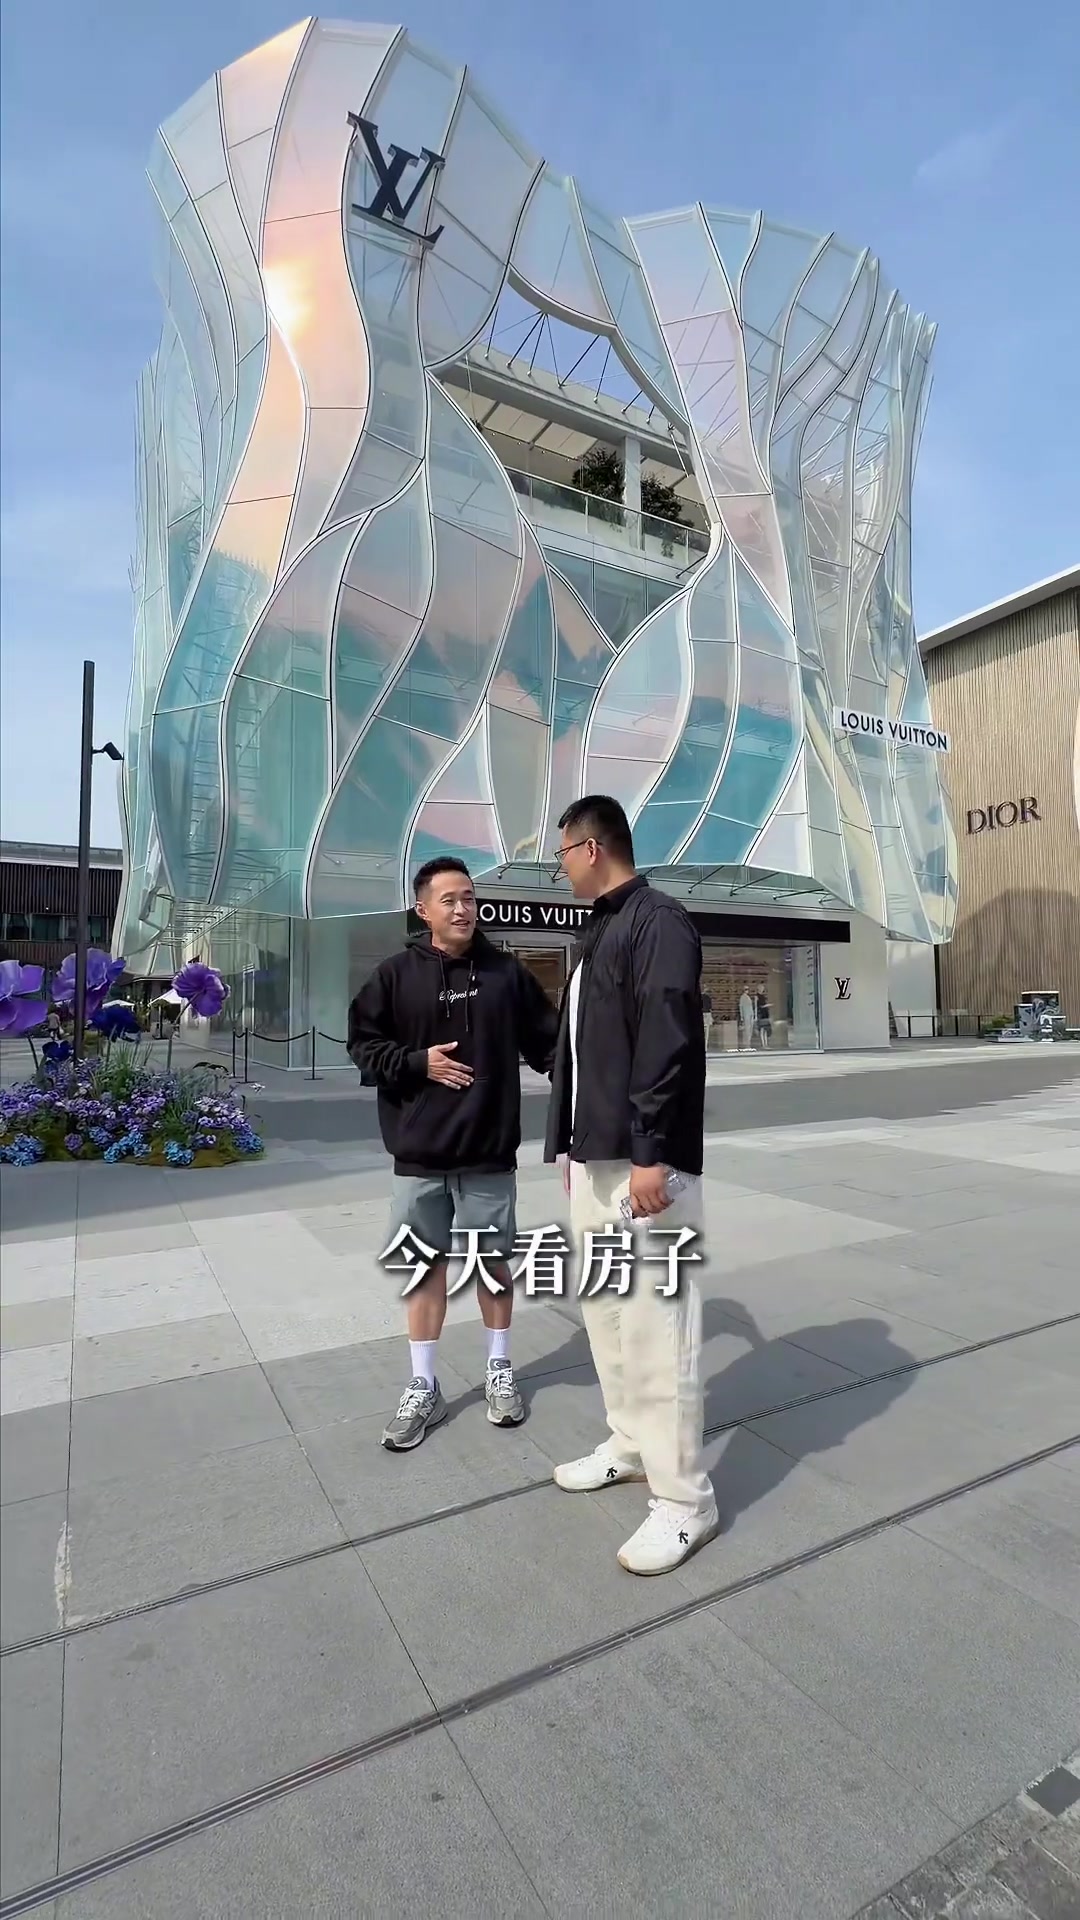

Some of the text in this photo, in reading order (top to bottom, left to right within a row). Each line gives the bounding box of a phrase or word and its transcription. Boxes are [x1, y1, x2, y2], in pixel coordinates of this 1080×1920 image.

[841, 710, 948, 751] LOUIS VUITTON
[965, 796, 1042, 836] DIOR
[476, 903, 533, 924] OUIS
[834, 977, 852, 1000] LV
